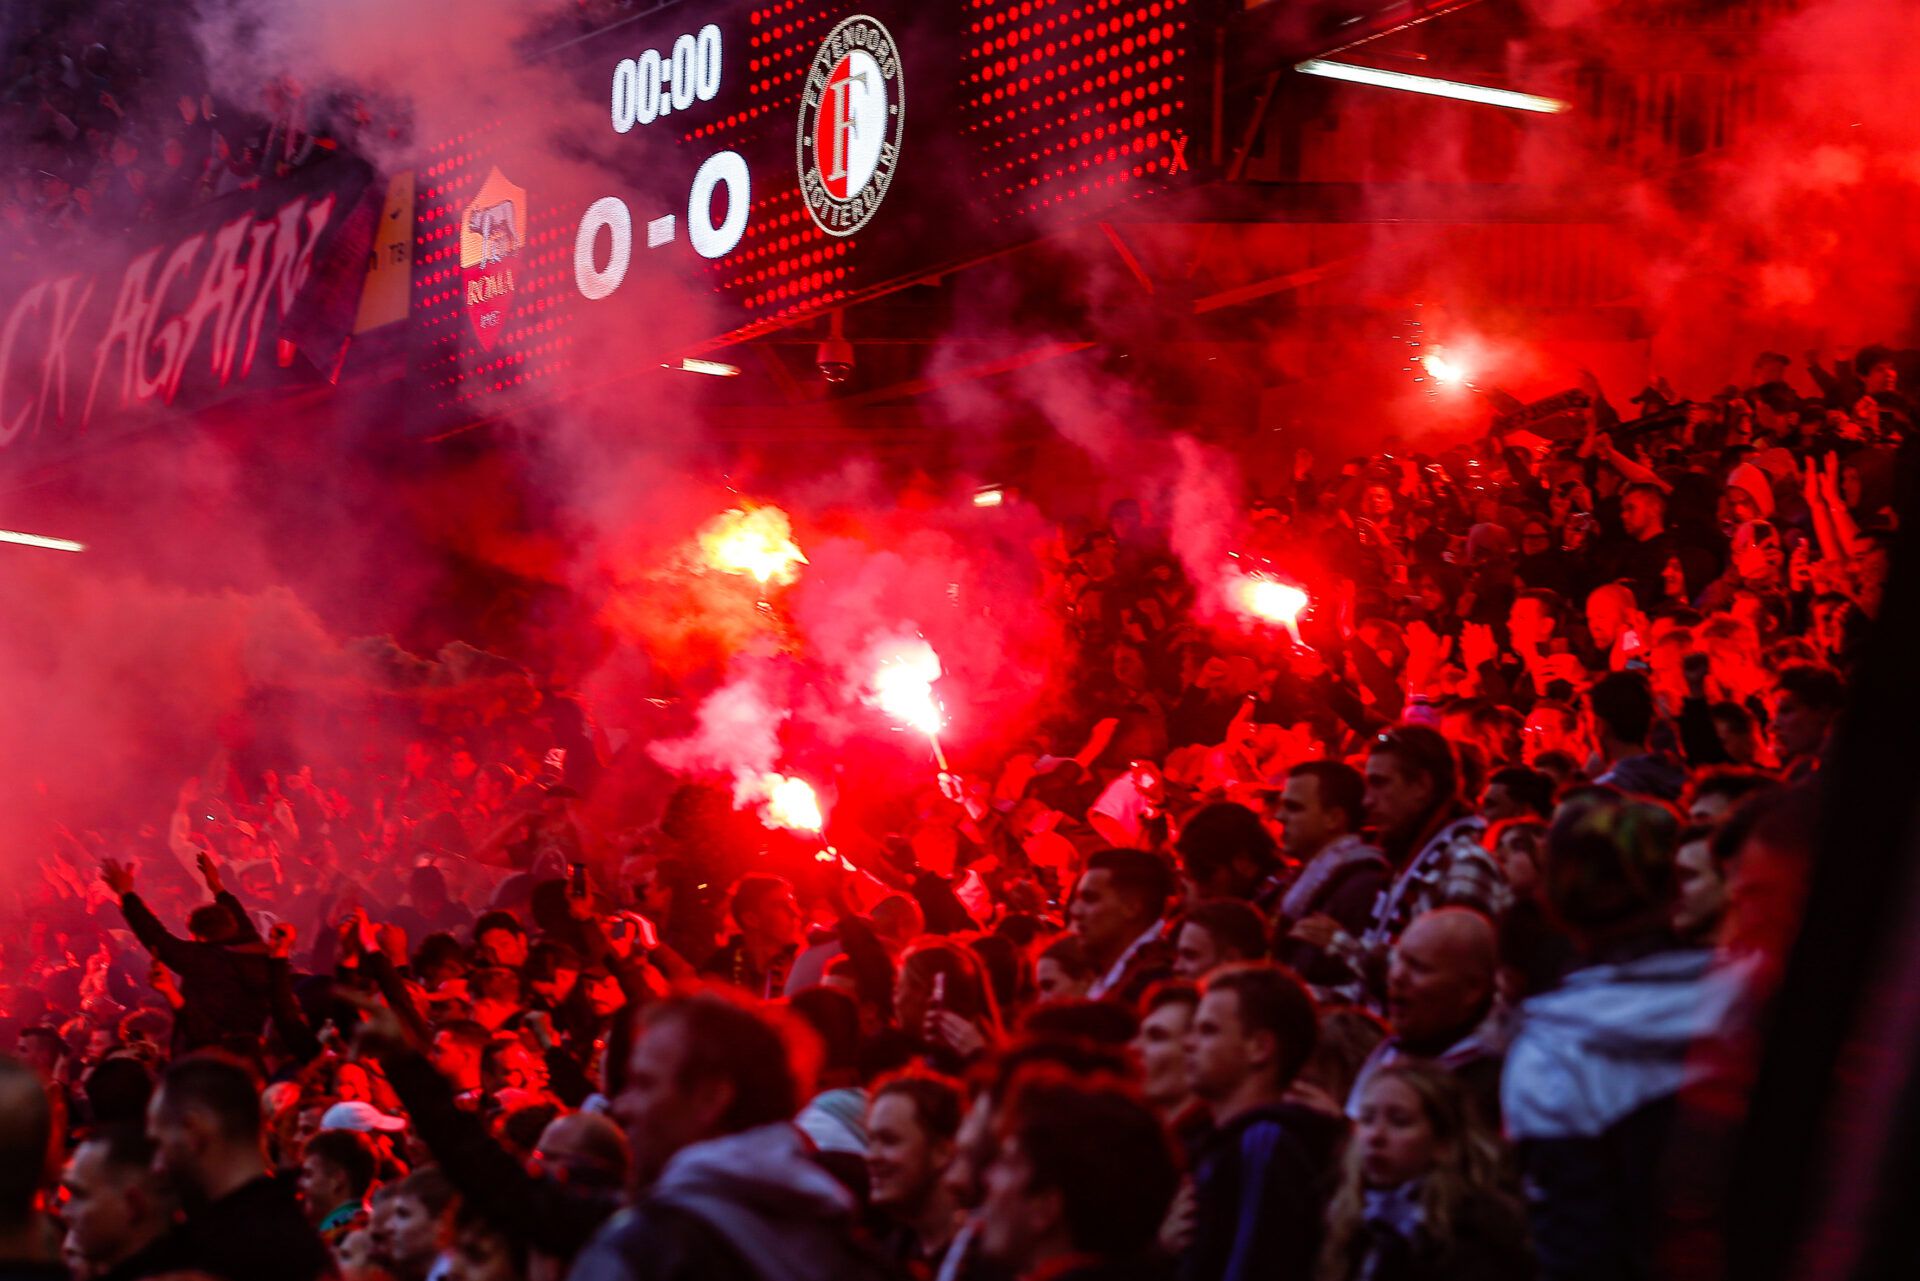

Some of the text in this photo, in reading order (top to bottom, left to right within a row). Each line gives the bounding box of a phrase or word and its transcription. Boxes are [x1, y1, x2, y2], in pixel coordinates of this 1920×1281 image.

[611, 24, 722, 133] 00:00
[806, 23, 896, 108] FEYENOORD
[826, 70, 869, 182] F
[805, 141, 897, 226] ROTTERDAM
[80, 192, 337, 437] AGAIN
